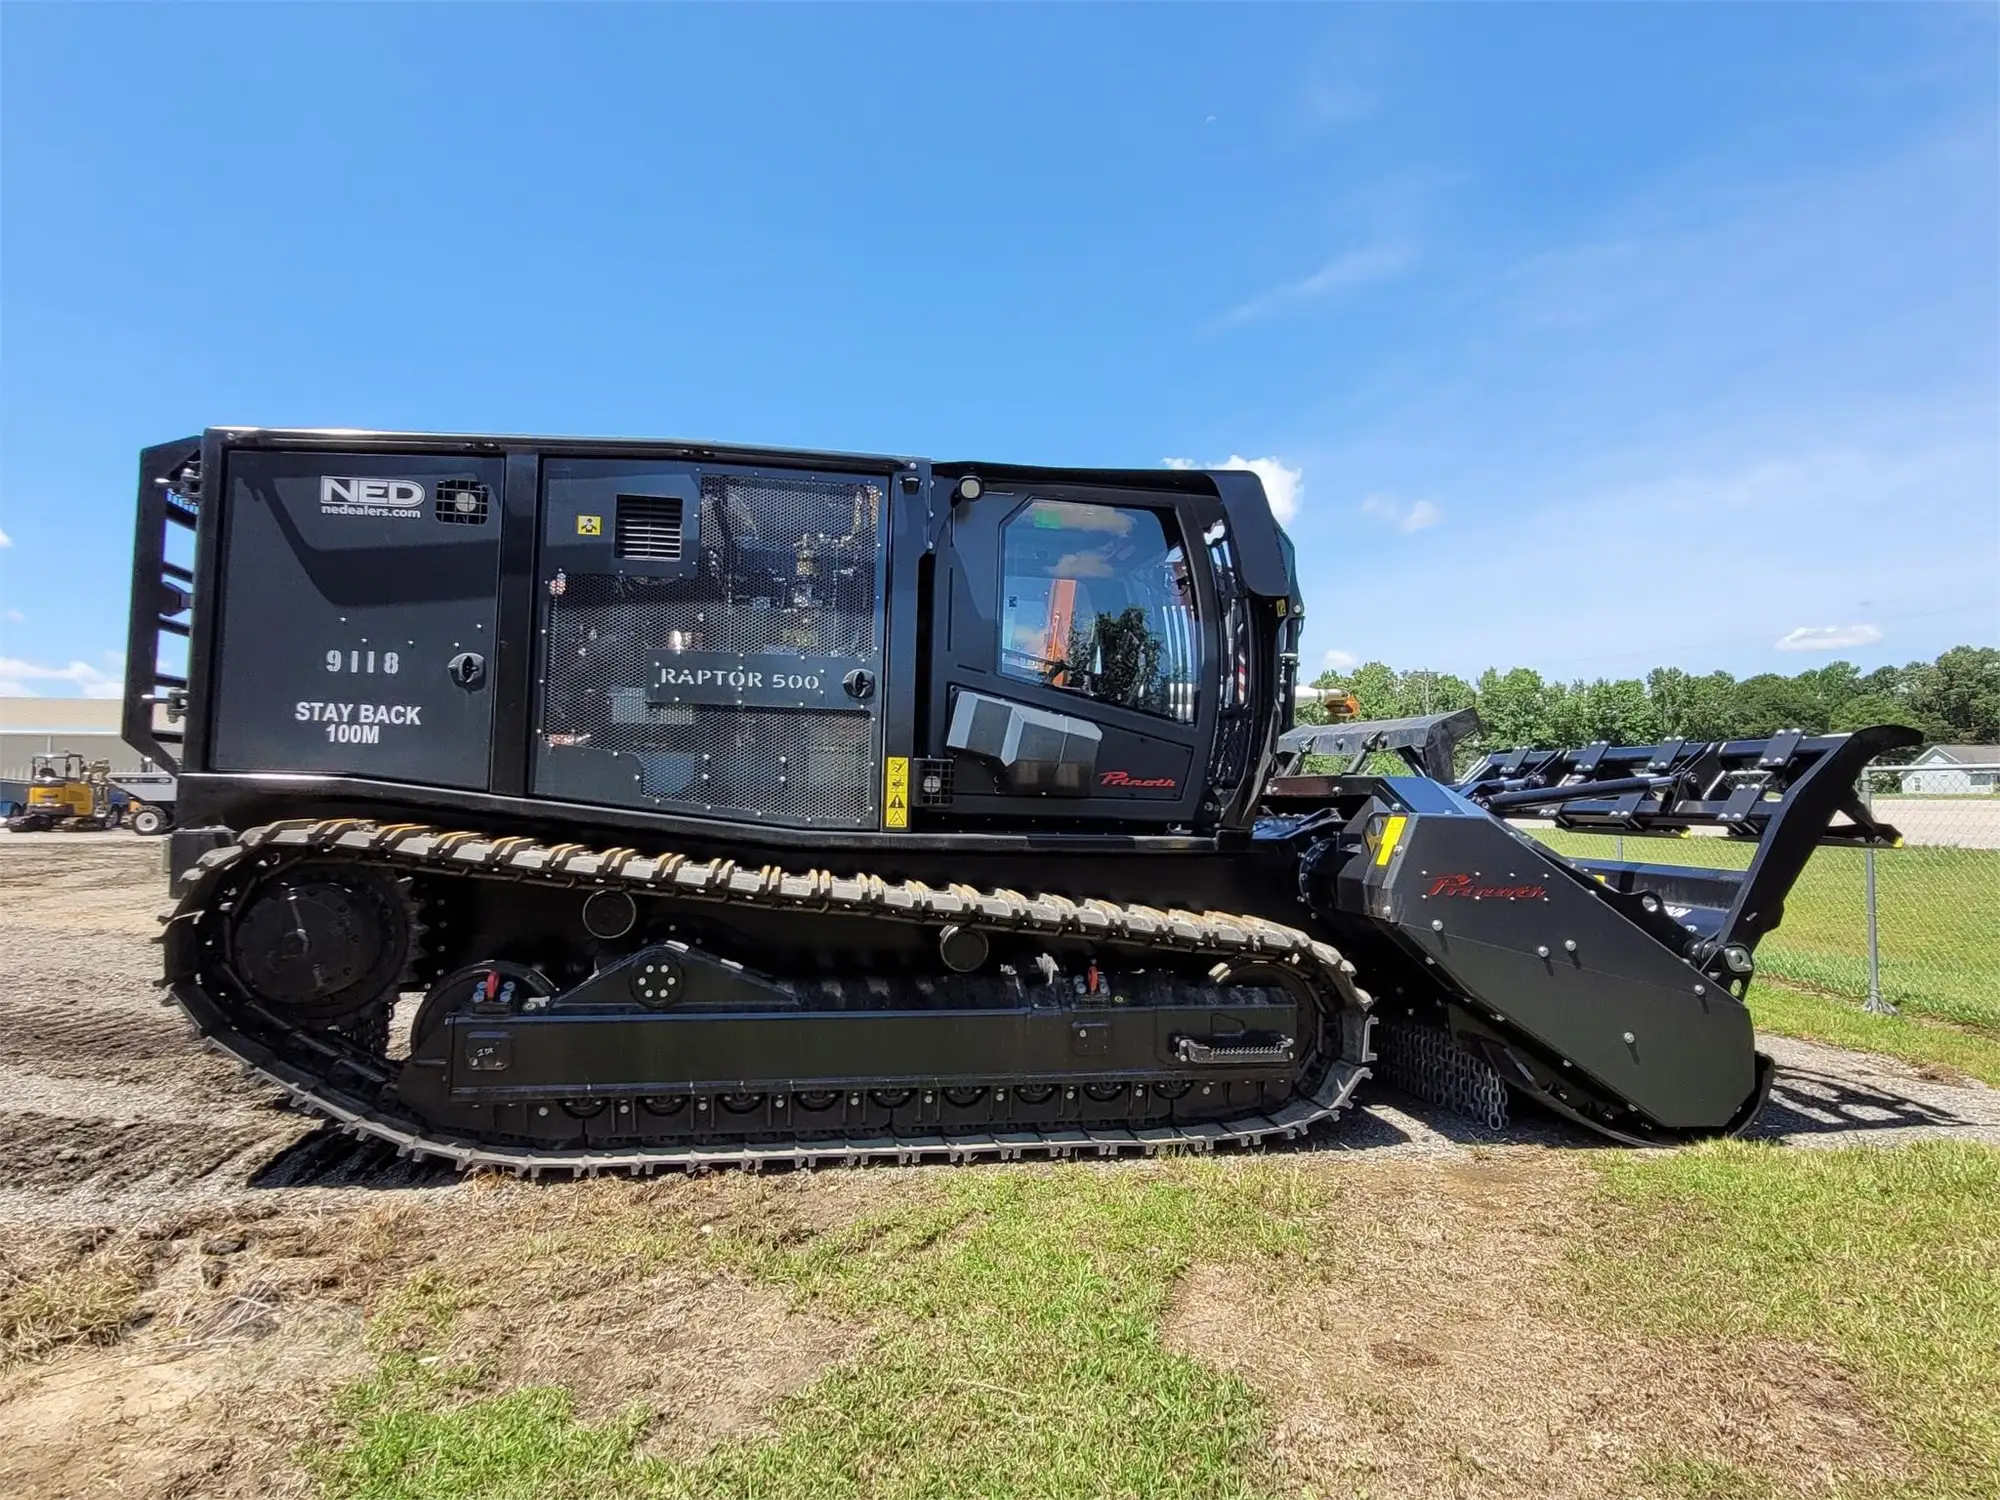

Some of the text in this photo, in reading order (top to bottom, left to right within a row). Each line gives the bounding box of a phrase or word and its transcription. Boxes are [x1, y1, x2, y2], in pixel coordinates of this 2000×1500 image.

[322, 477, 424, 506] NED
[321, 505, 421, 518] nedealers.com
[325, 650, 399, 674] 9118
[661, 668, 819, 689] RAPTOR 500
[295, 702, 422, 725] STAY BACK
[325, 724, 380, 744] 100M
